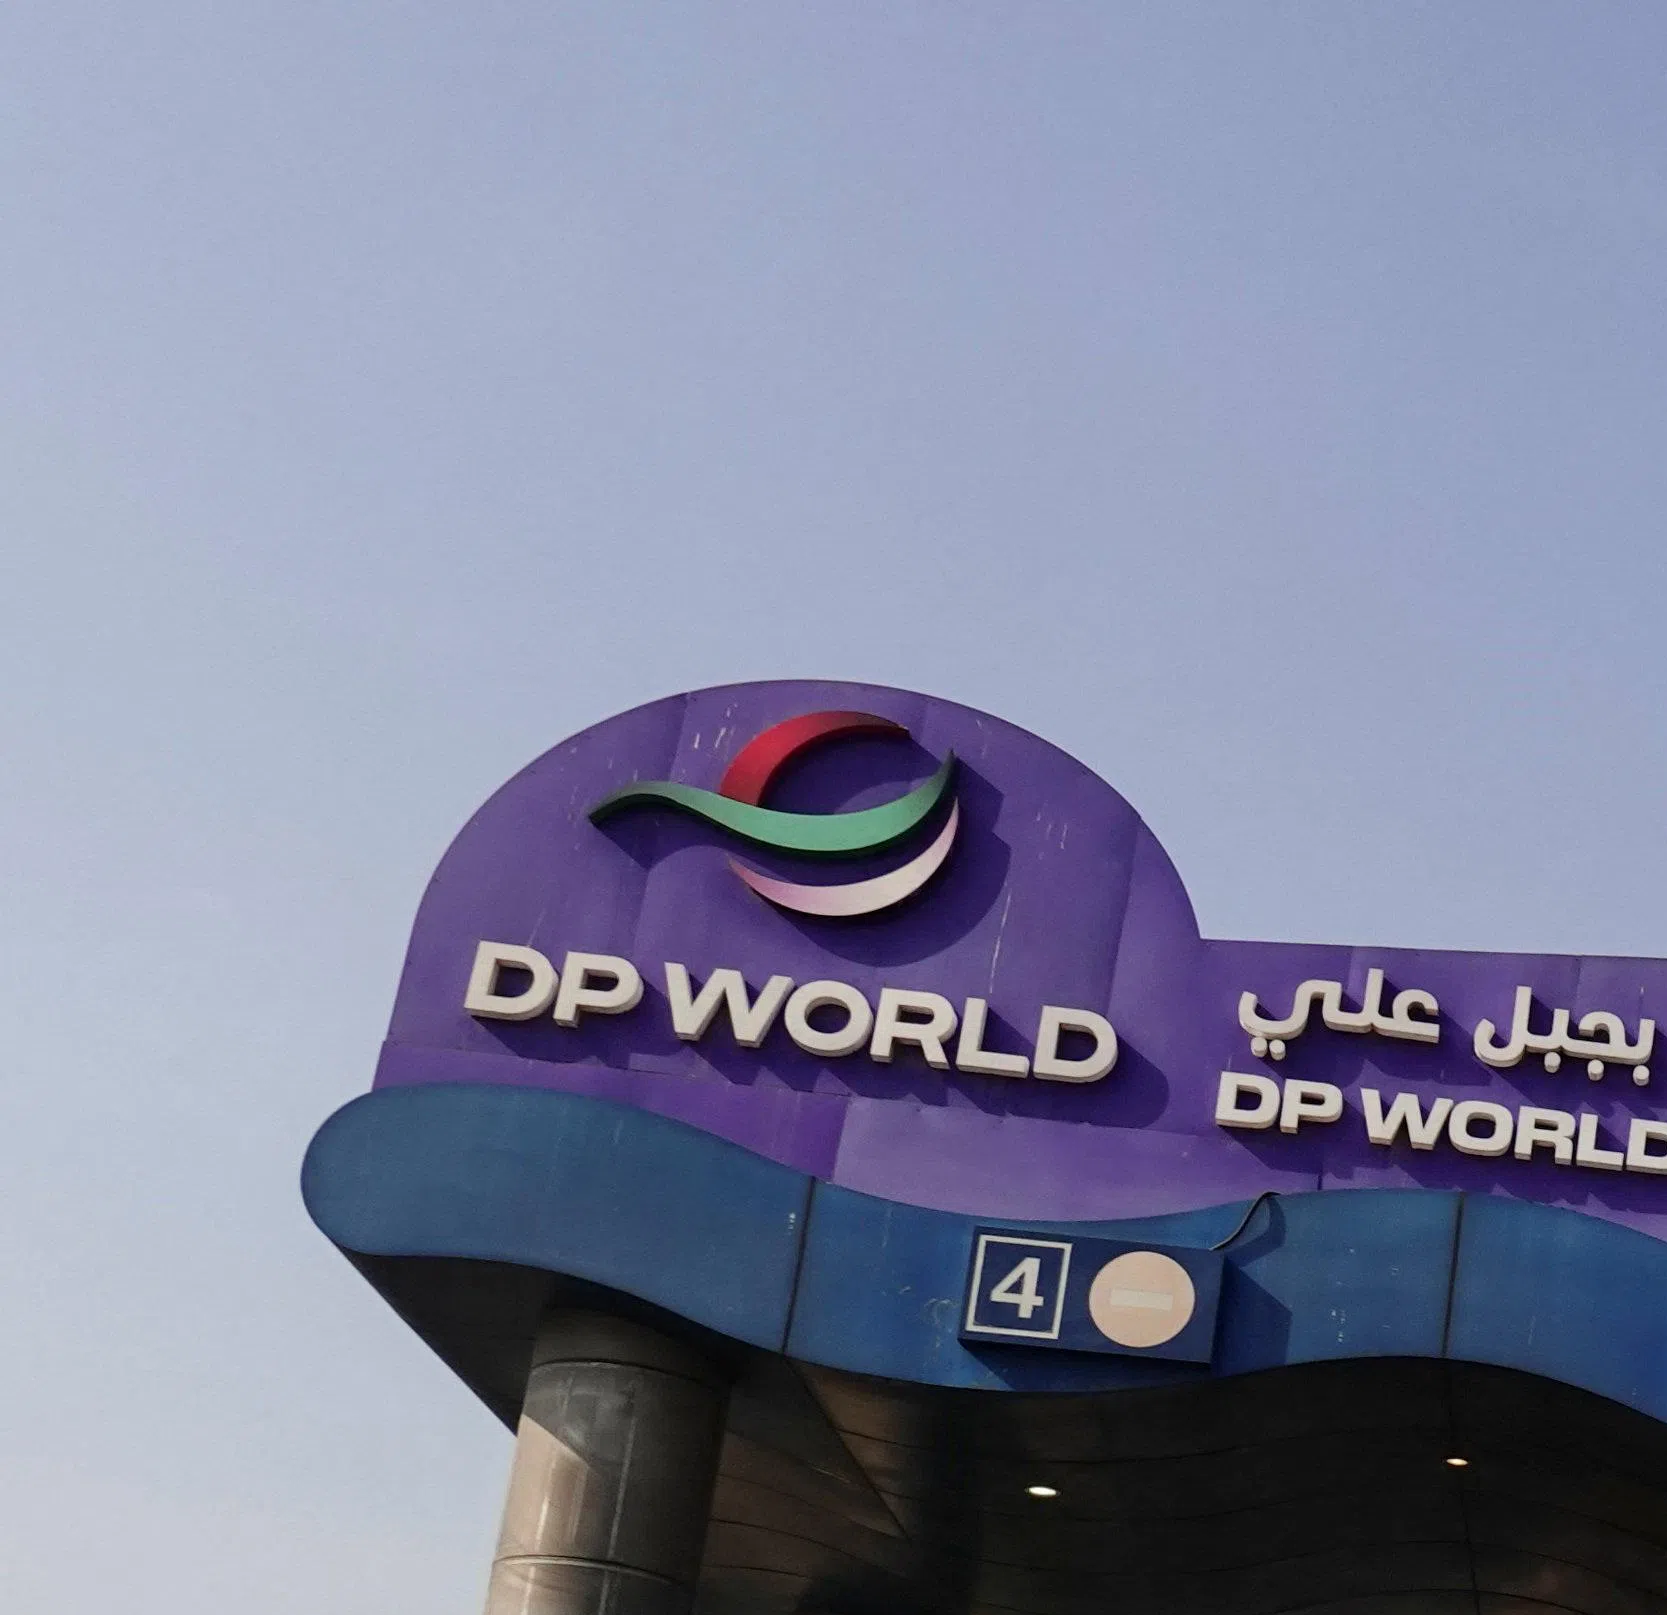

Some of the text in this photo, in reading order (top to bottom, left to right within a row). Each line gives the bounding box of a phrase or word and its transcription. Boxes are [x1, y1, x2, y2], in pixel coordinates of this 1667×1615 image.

[464, 940, 1119, 1083] DP WORLD
[1239, 968, 1439, 1060] علي
[1474, 985, 1655, 1085] بجبل
[1215, 1071, 1343, 1133] DP
[990, 1257, 1044, 1319] 4
